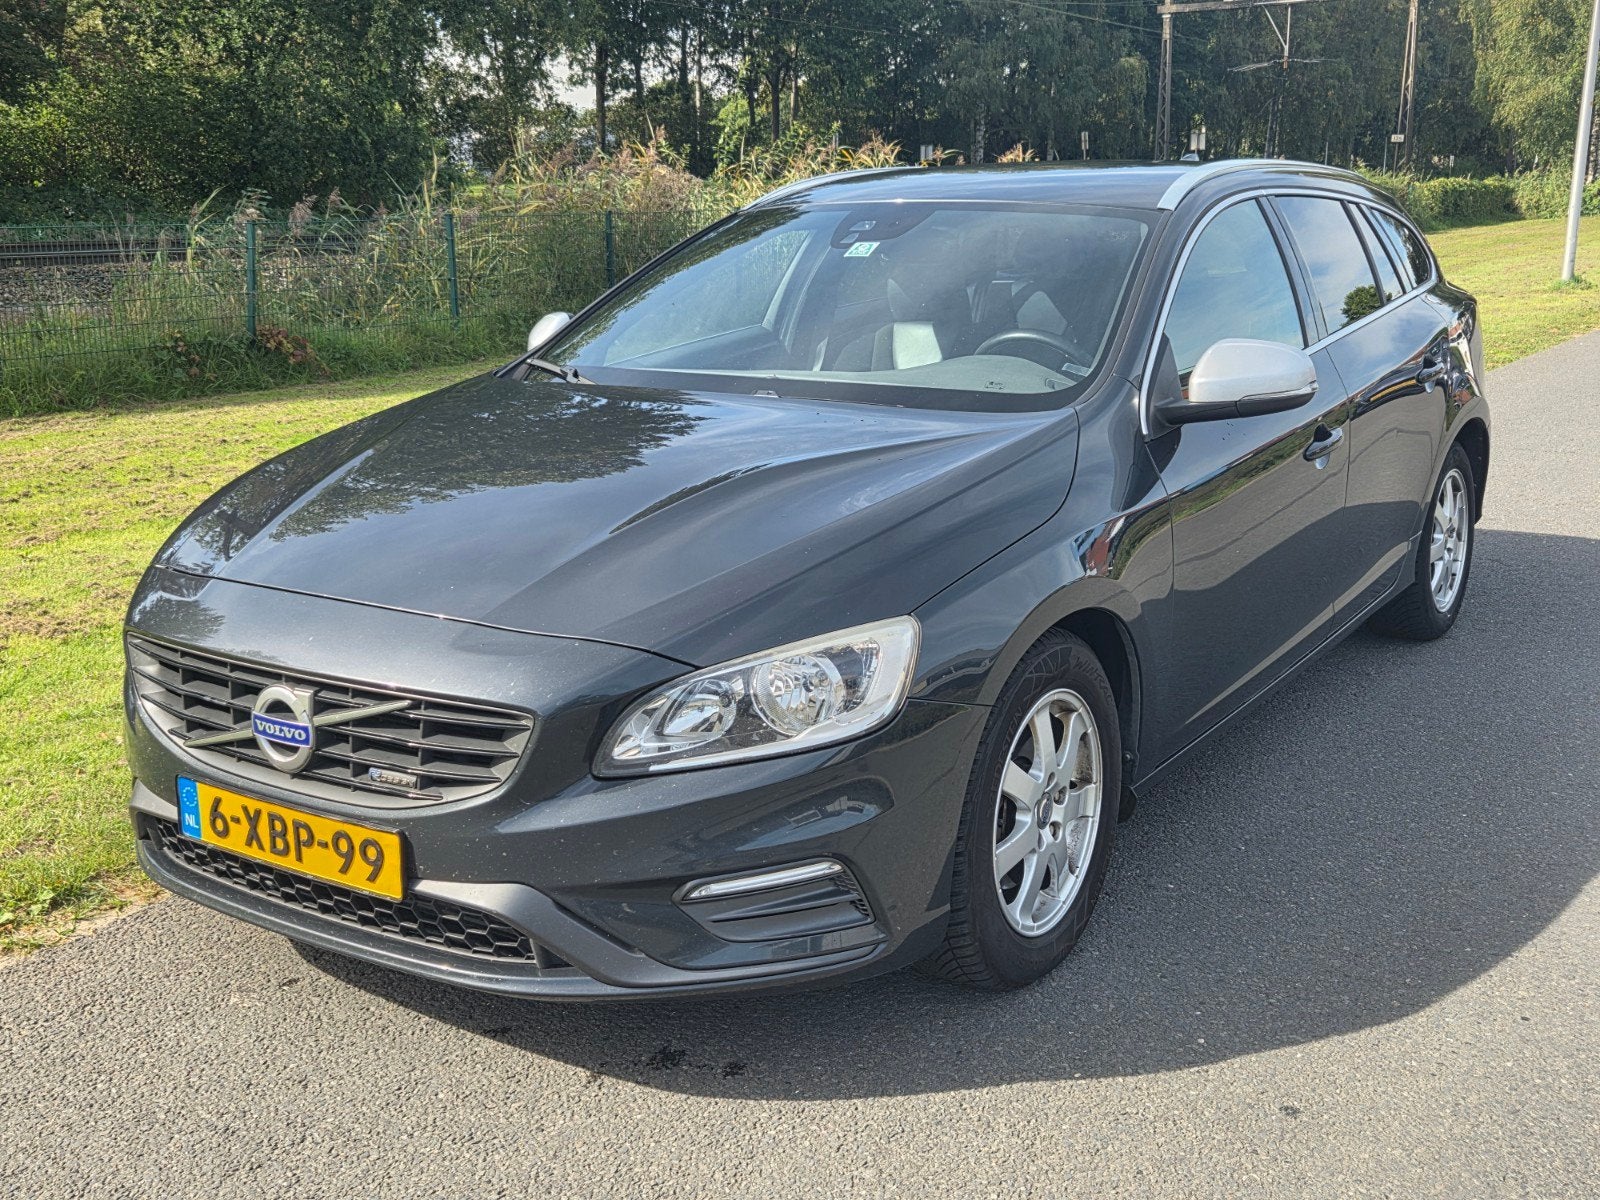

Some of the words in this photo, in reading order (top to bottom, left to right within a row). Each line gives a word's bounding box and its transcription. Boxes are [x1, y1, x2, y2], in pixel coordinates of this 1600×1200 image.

[254, 718, 306, 741] VOLVO
[185, 812, 199, 828] NL
[209, 796, 385, 884] 6-XBP-99
